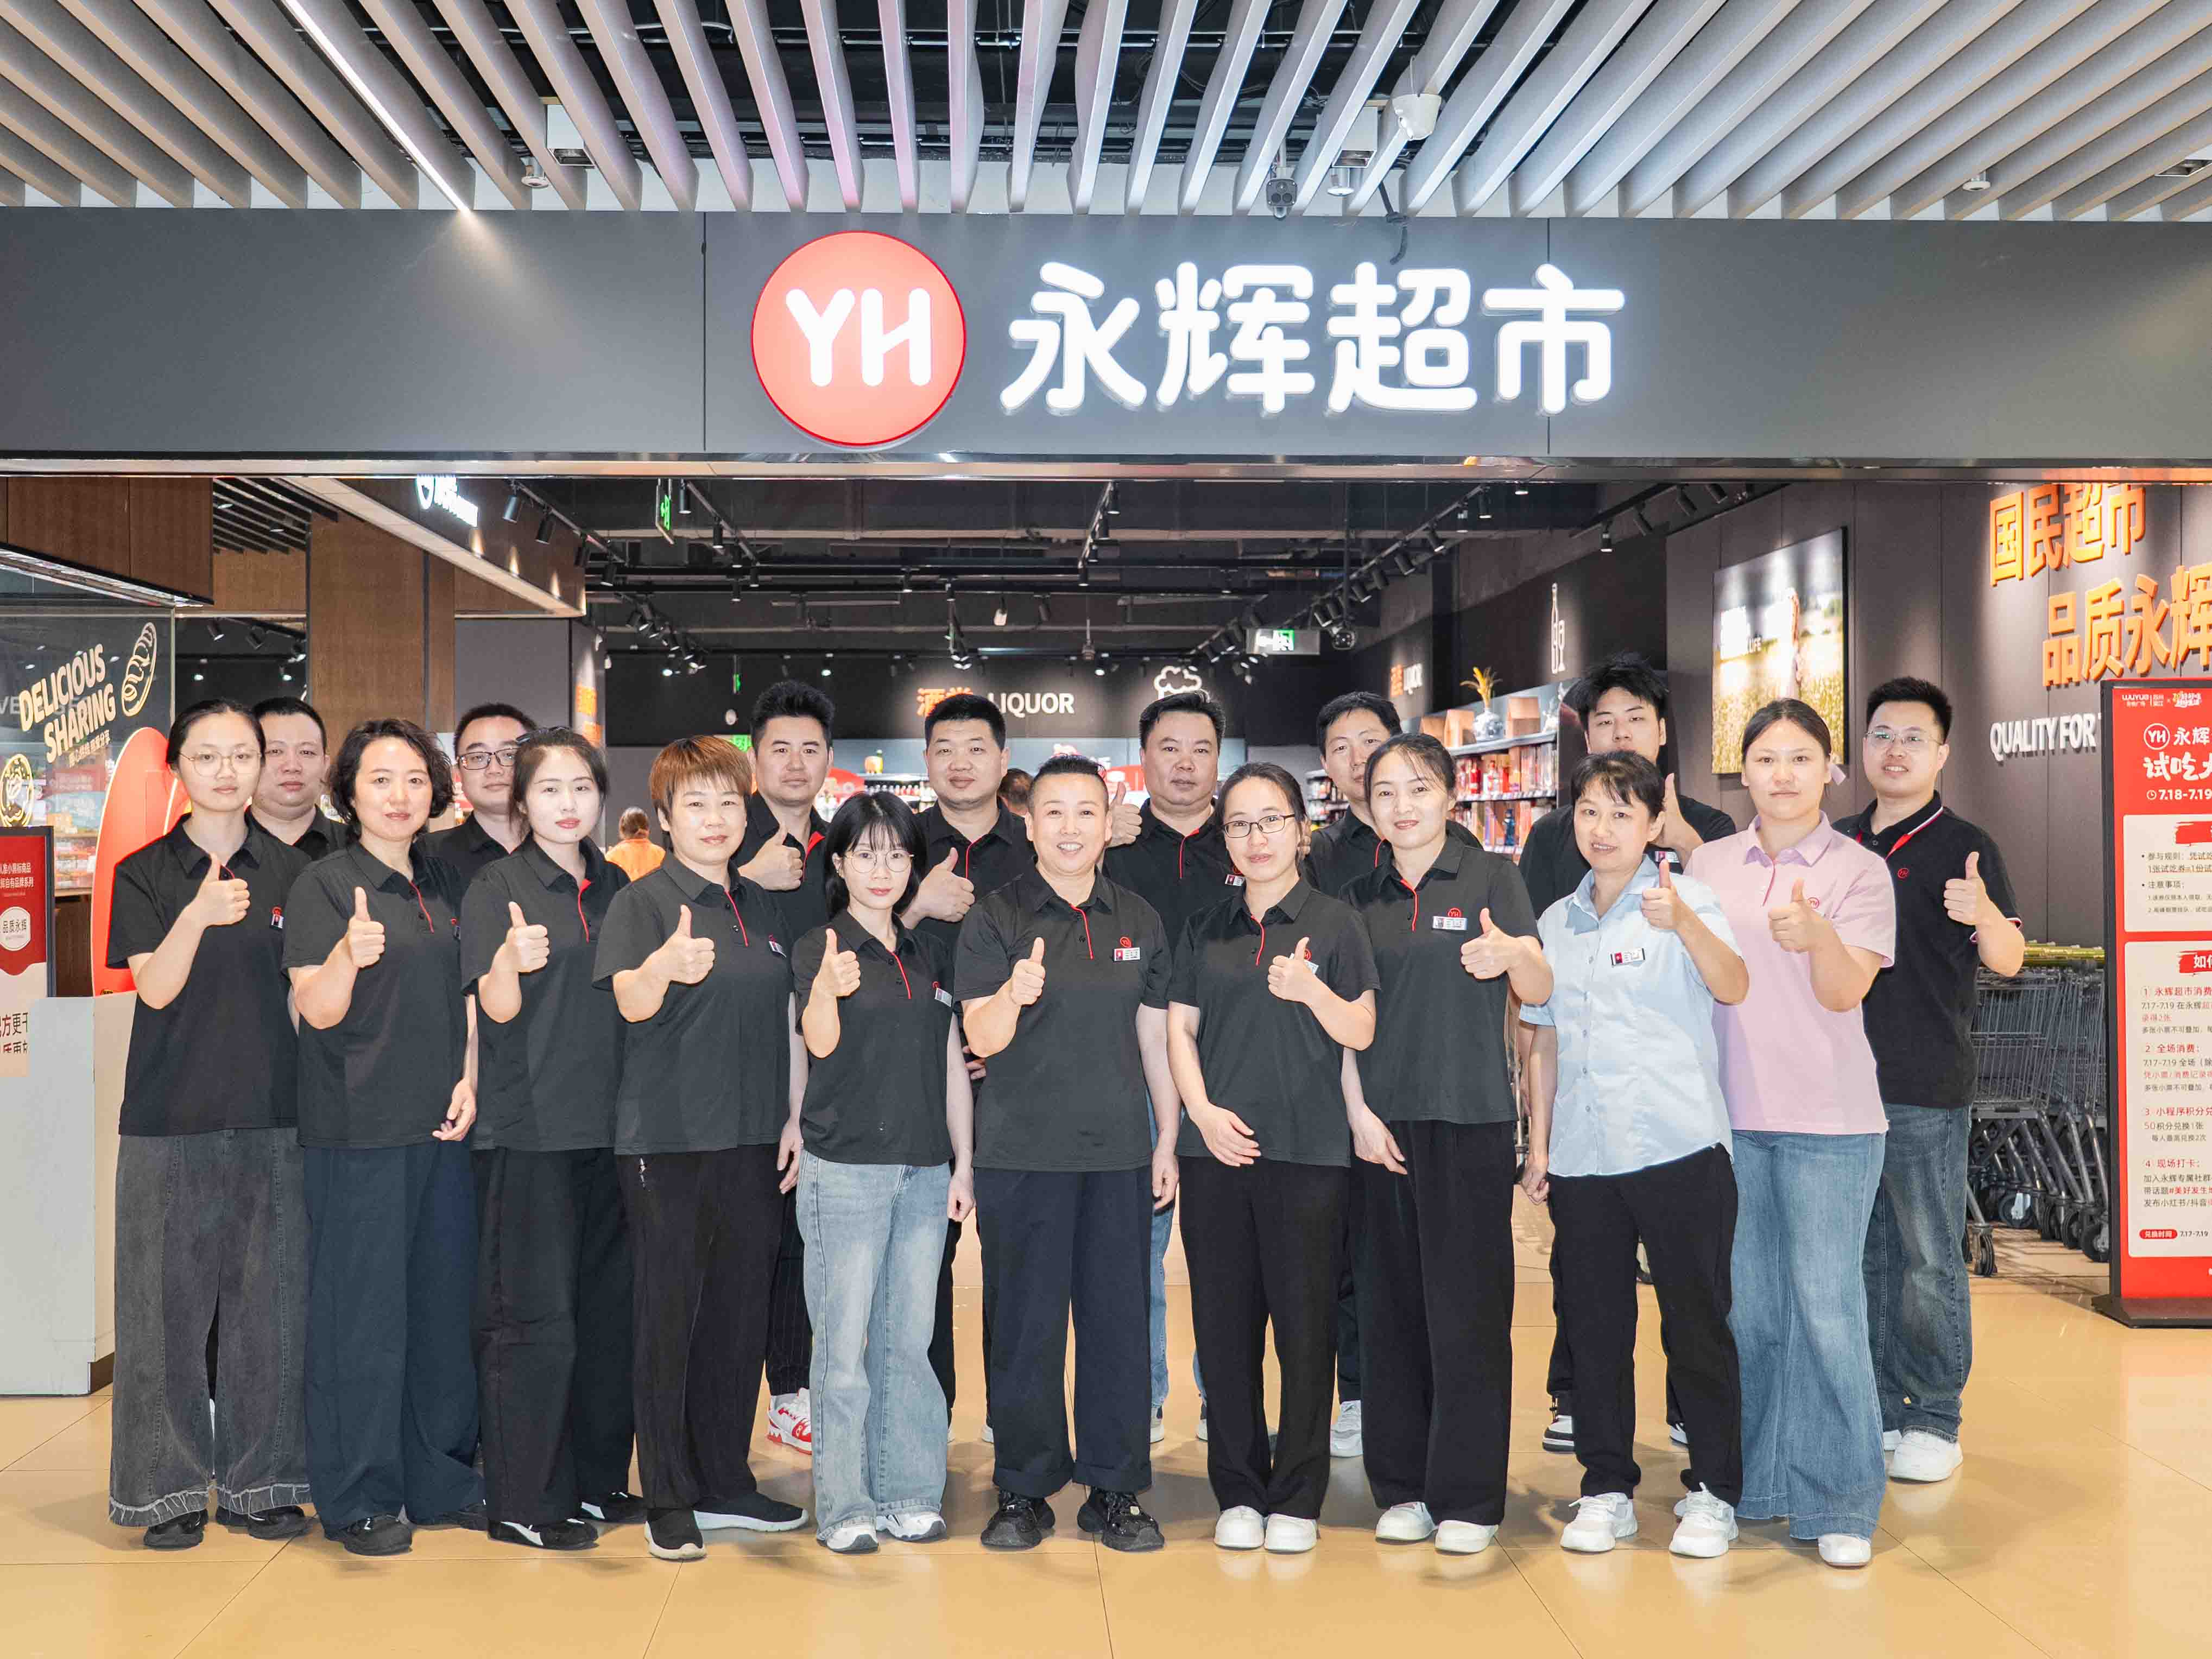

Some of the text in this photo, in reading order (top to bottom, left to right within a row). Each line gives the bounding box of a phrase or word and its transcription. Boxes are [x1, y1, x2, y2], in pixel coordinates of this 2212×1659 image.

[786, 288, 934, 388] YH
[1001, 261, 1625, 416] 永辉超市
[1989, 483, 2146, 587] 国民超市
[2043, 562, 2212, 687] 品质永辉
[19, 643, 106, 732] DELICIOUS
[44, 682, 116, 763] SHARING
[1990, 713, 2096, 761] QUALITY FOR
[2147, 730, 2166, 743] YH
[2173, 726, 2210, 745] 永辉
[2158, 789, 2212, 800] 7.18-7.19
